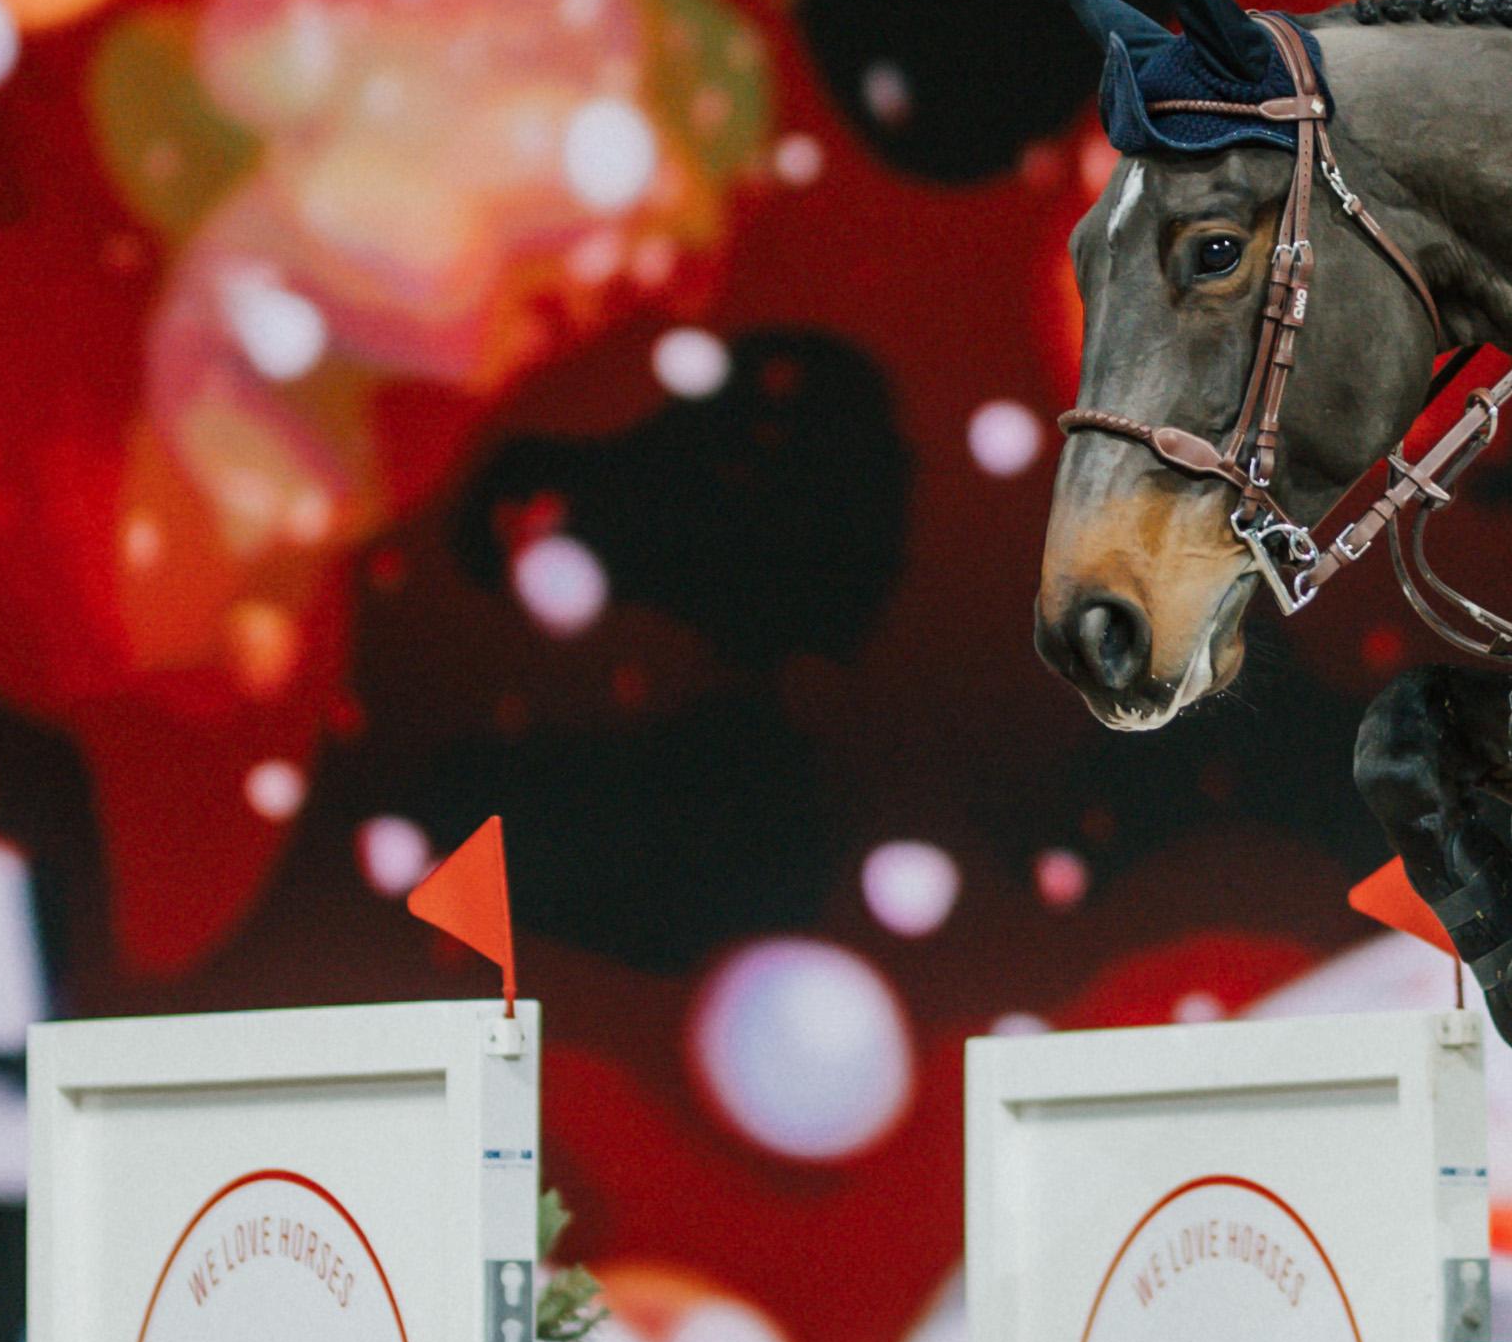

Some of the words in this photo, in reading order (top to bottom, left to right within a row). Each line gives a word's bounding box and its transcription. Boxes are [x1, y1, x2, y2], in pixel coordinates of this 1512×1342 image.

[188, 1248, 220, 1308] WE
[221, 1215, 271, 1271] LOVE
[278, 1217, 355, 1308] HORSES
[1168, 1219, 1219, 1272] LOVE
[1228, 1221, 1306, 1308] HORSES
